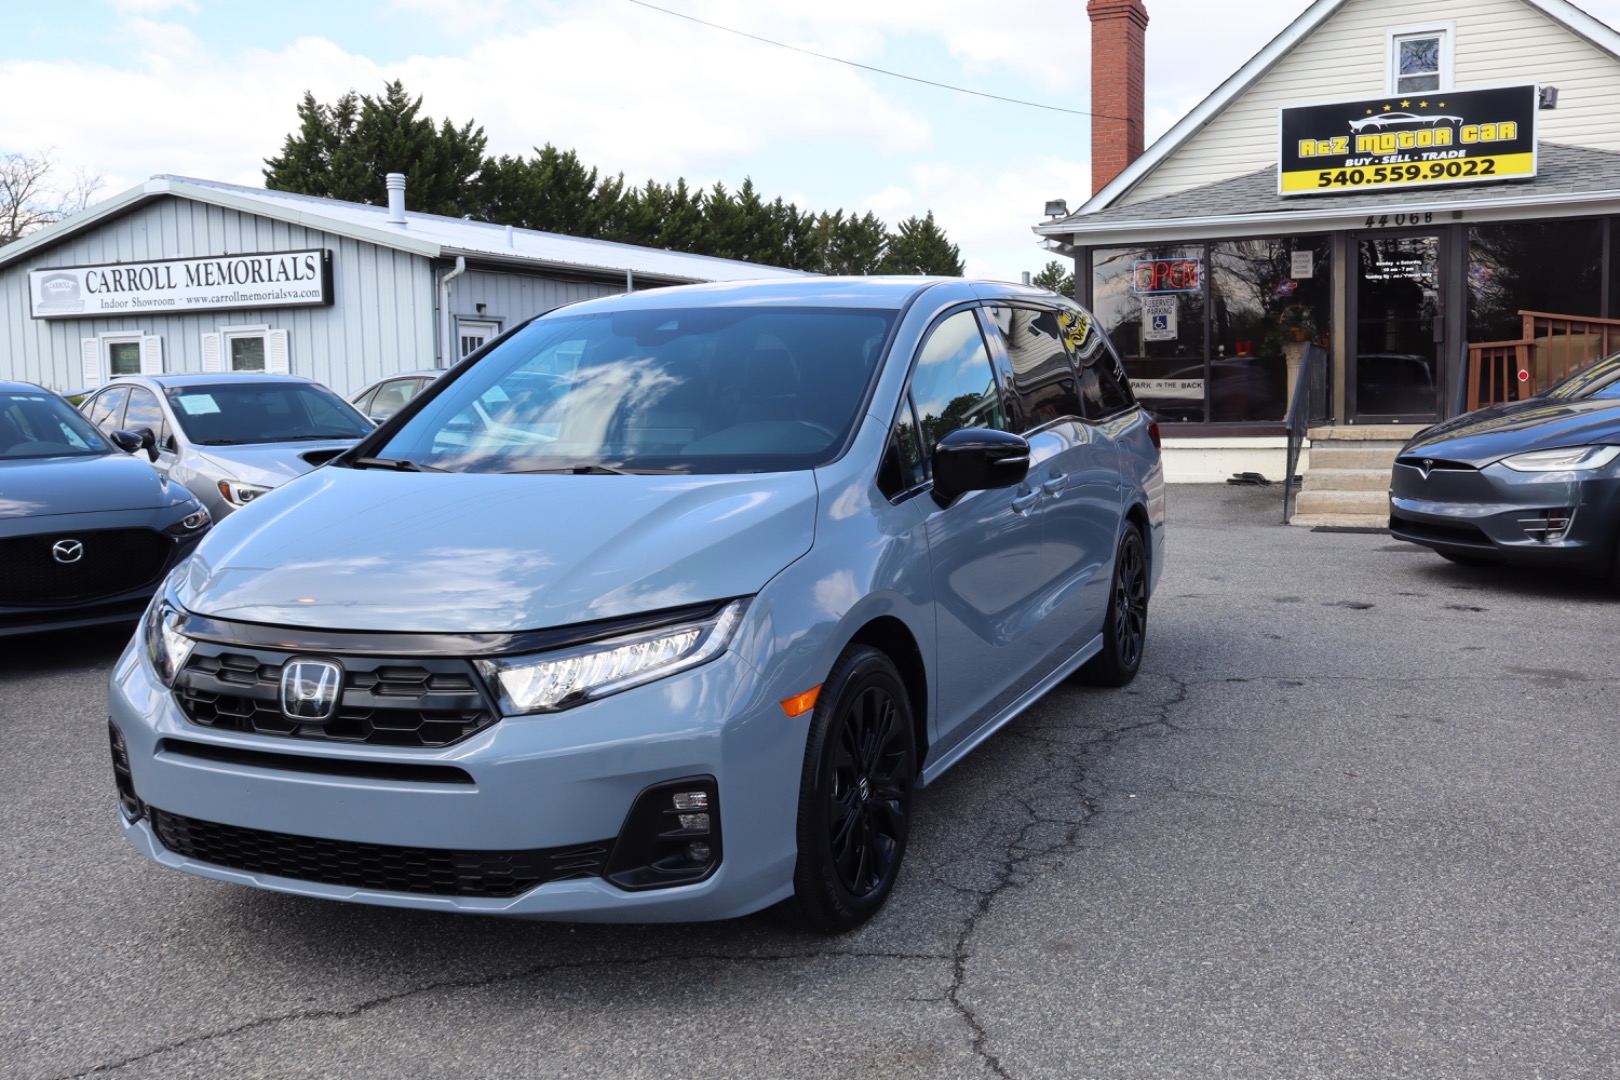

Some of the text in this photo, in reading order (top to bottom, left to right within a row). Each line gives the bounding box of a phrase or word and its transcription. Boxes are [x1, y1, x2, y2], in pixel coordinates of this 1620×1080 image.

[1299, 136, 1349, 158] A&Z
[1345, 150, 1467, 167] BUY SELL TRADE
[1318, 158, 1496, 188] 540.559.9022
[49, 281, 71, 289] CARROLL
[85, 255, 316, 294] CARROLL MEMORIALS
[1136, 260, 1198, 290] OPEN
[100, 288, 320, 309] Indoor Showroom www.carrollmemorialsva.com
[1146, 307, 1173, 316] PARKING
[1130, 381, 1151, 389] PARK
